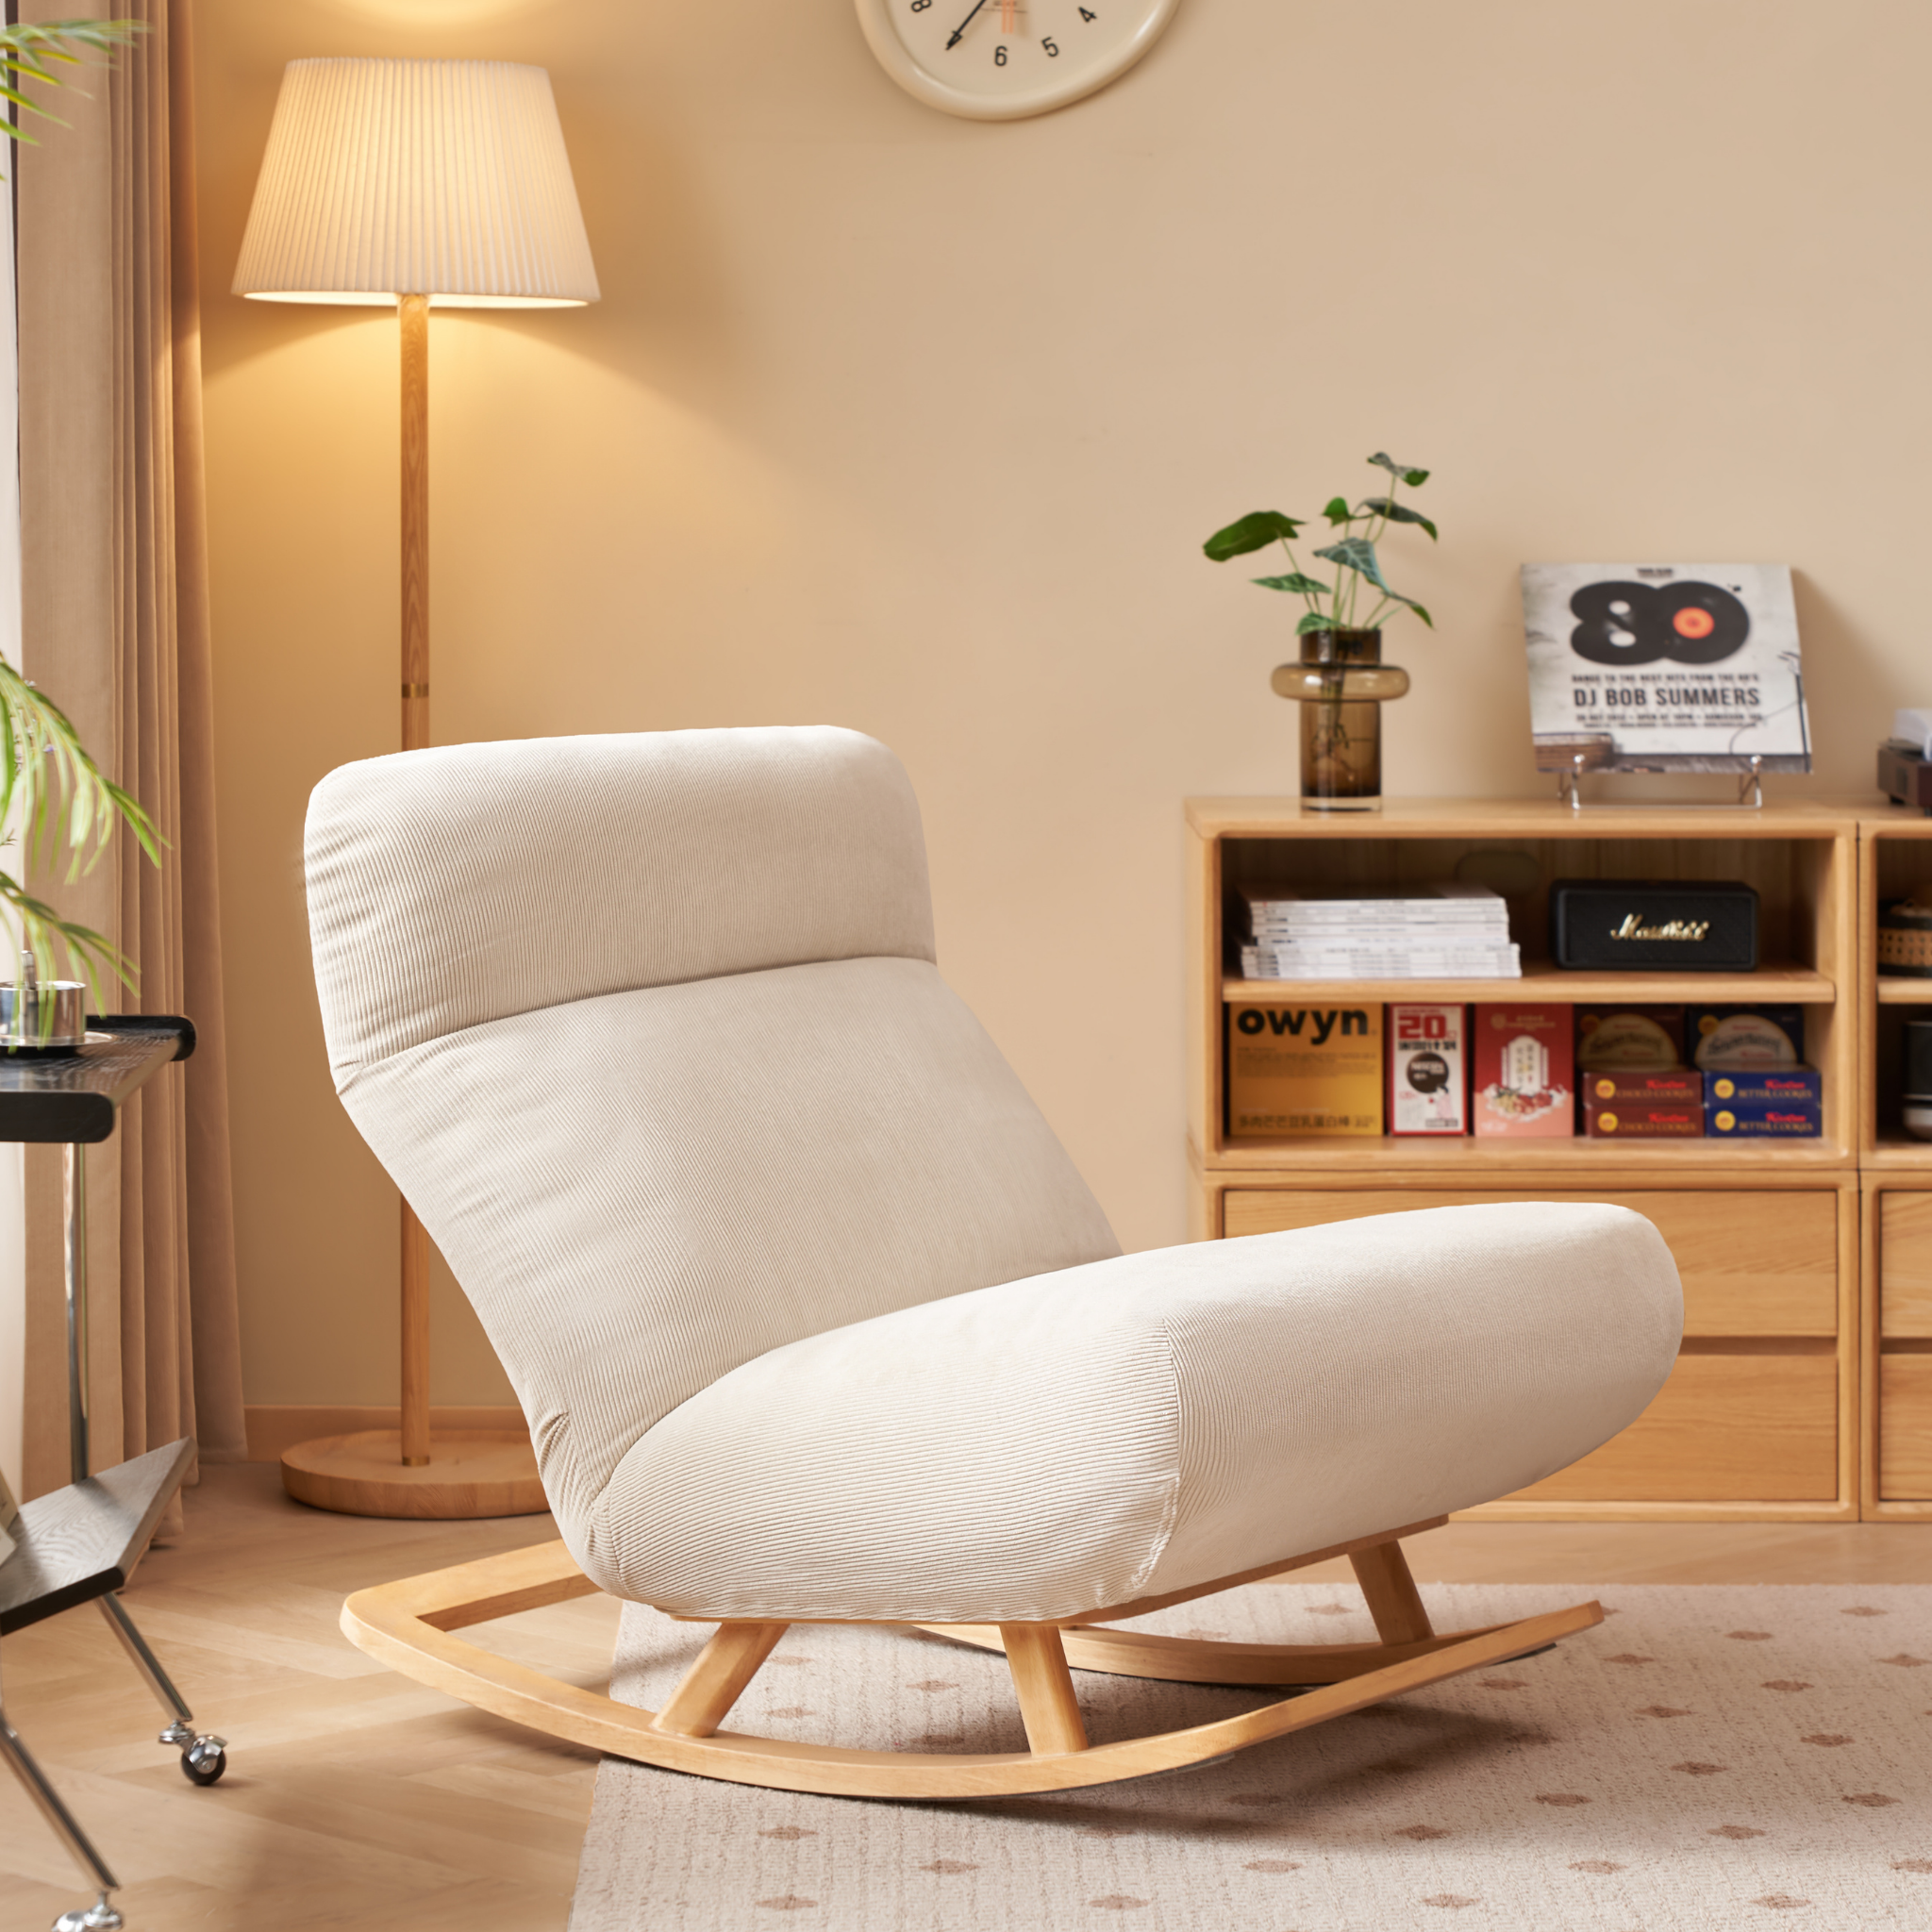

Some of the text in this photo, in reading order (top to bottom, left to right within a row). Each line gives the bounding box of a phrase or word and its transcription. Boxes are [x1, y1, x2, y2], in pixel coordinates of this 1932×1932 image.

[910, 0, 932, 13] 8
[1077, 7, 1097, 24] 4
[993, 44, 1008, 67] 6
[1041, 36, 1059, 58] 5
[1574, 688, 1760, 707] DJ BOB SUMMERS
[1237, 1008, 1369, 1046] owyn
[1398, 1015, 1447, 1040] 20
